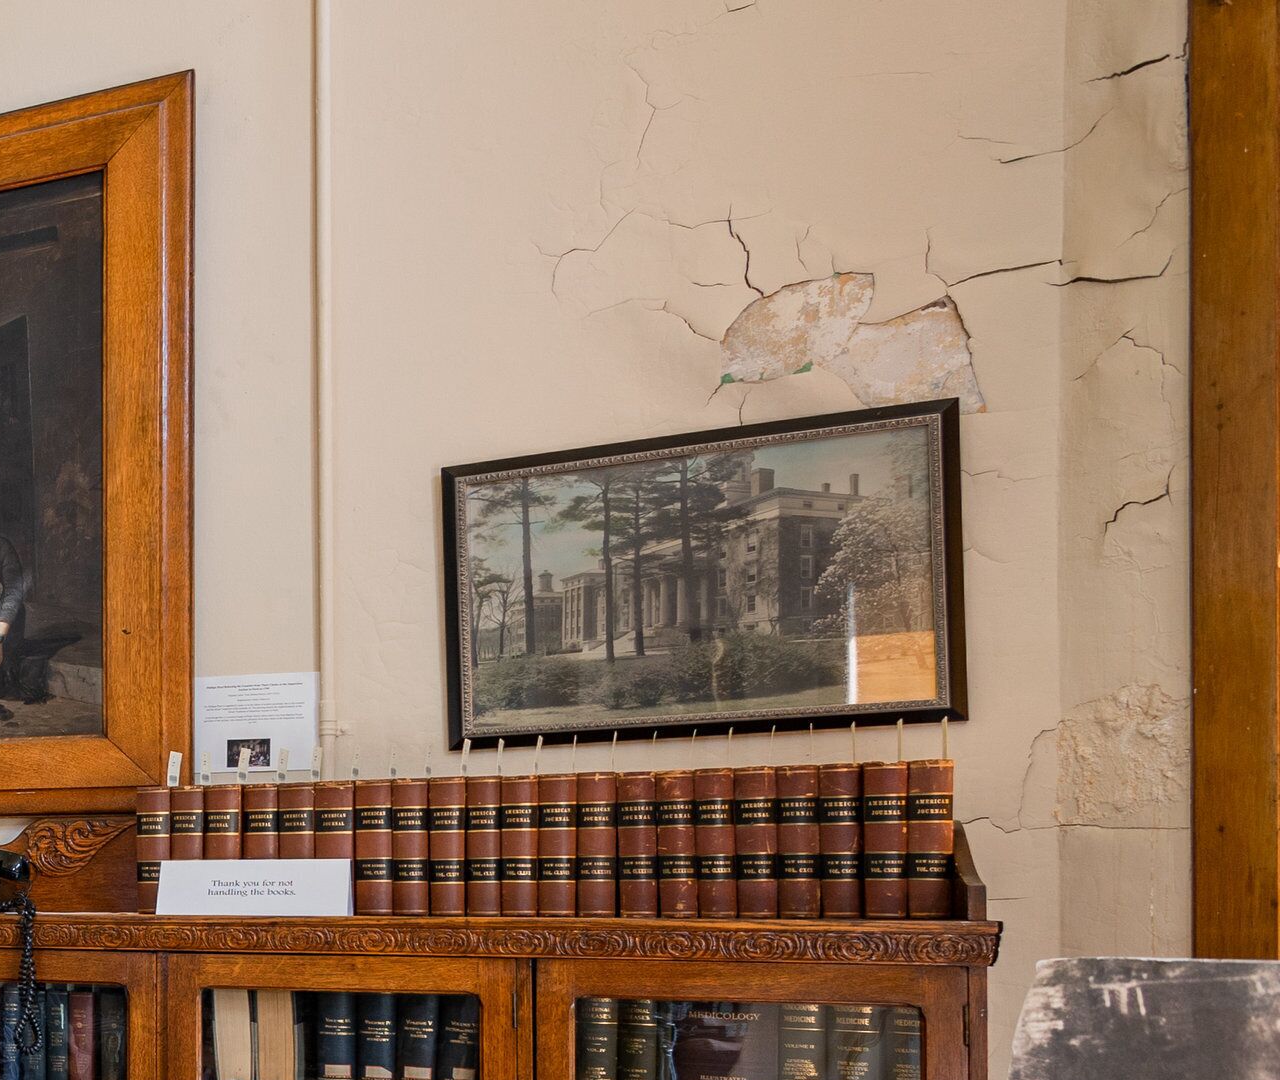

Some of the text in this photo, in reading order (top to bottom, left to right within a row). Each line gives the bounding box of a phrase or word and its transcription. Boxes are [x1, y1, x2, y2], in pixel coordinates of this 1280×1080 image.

[208, 889, 248, 897] handling
[689, 1011, 760, 1021] MEDICOLOGY
[784, 1016, 816, 1024] MEDICINE
